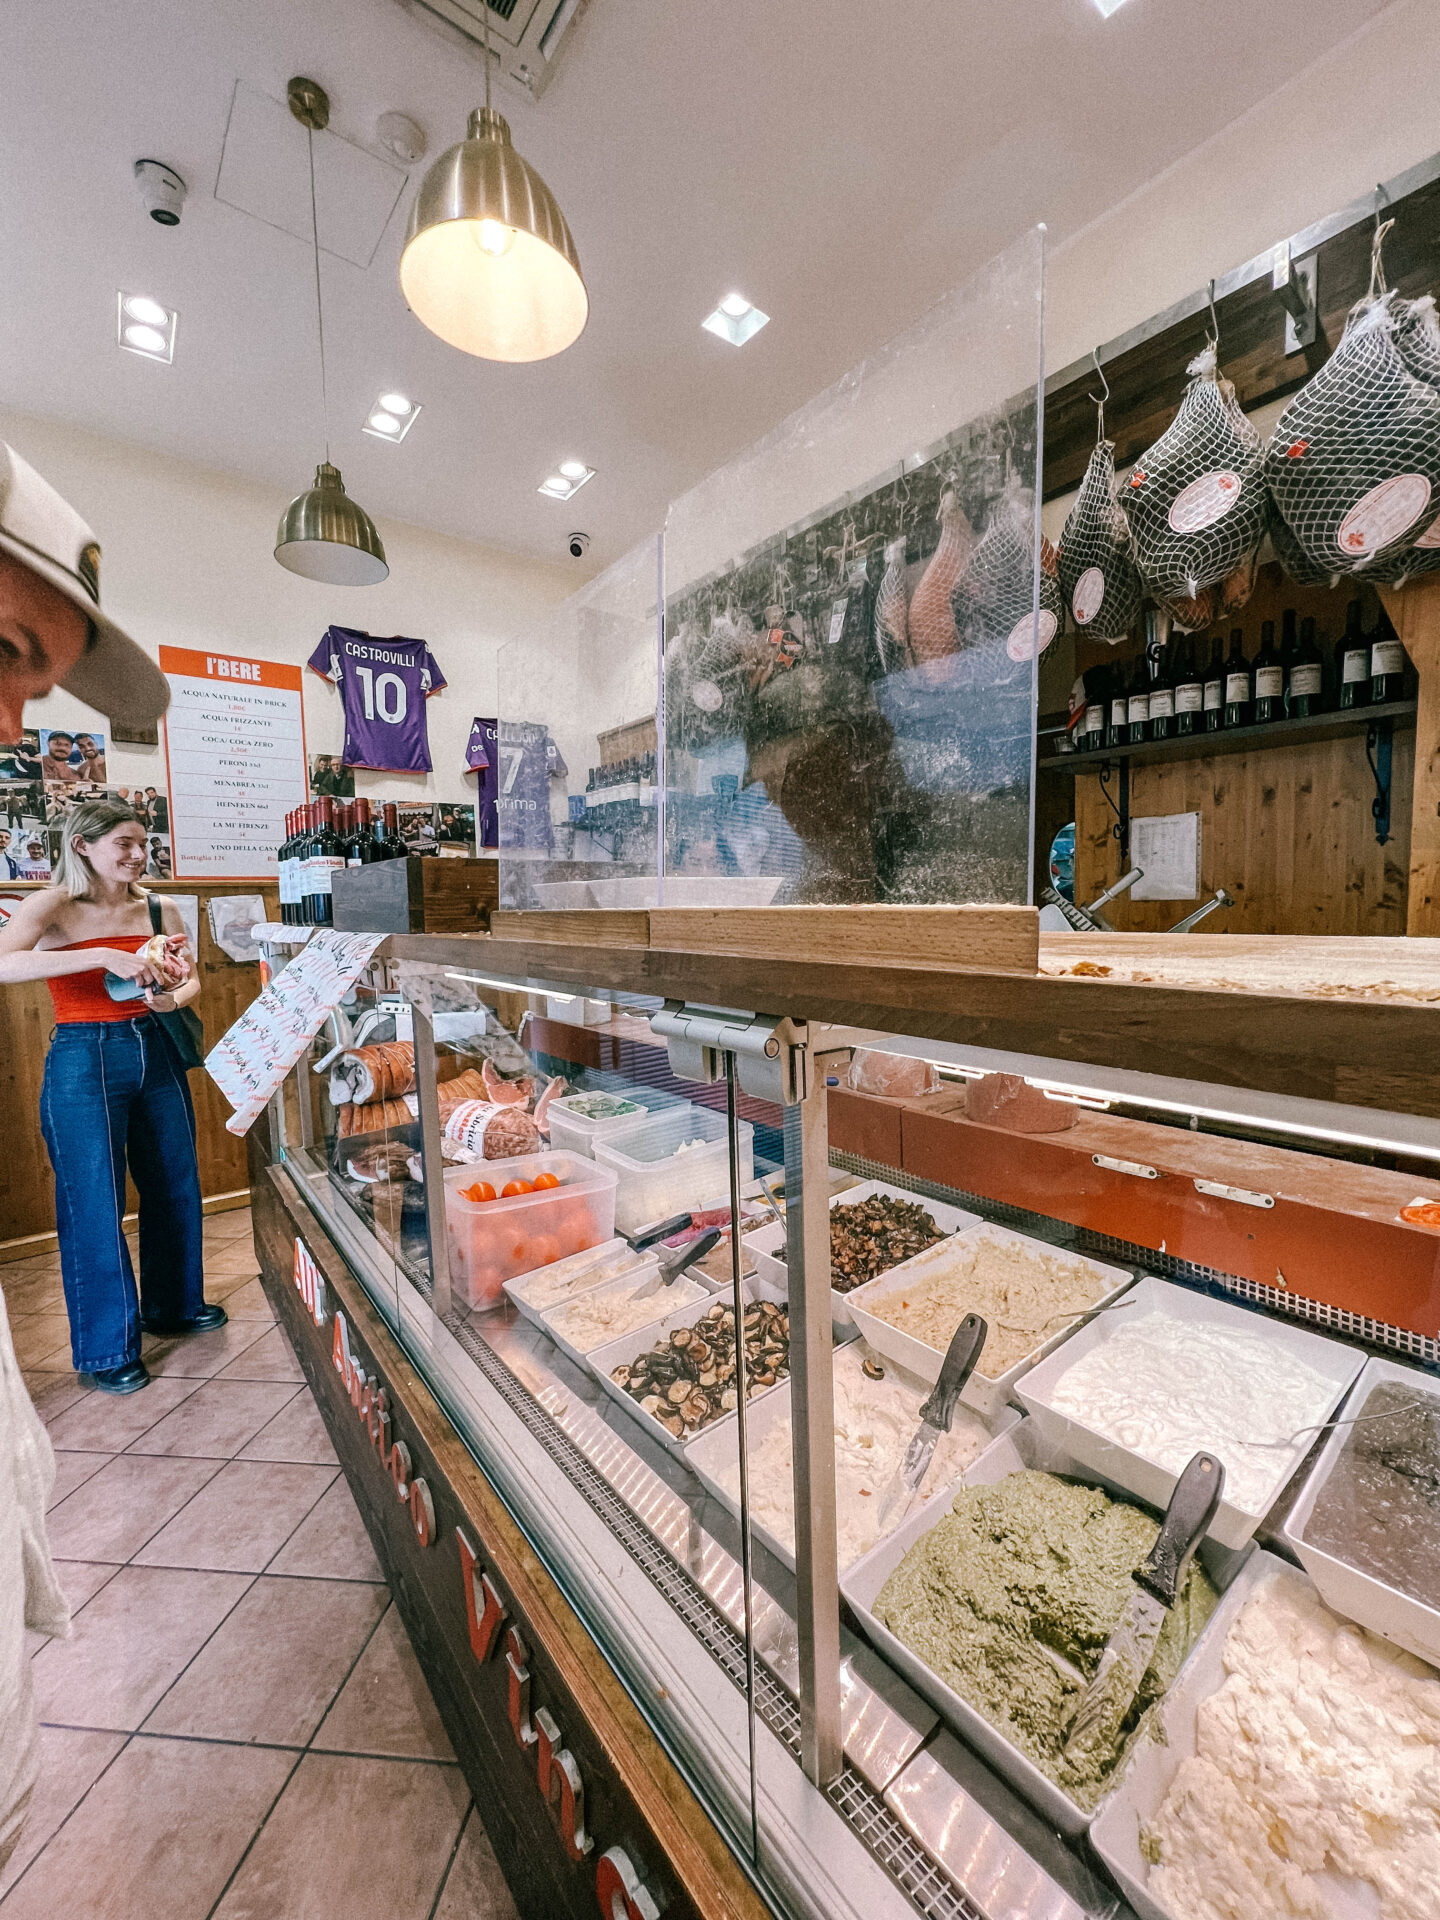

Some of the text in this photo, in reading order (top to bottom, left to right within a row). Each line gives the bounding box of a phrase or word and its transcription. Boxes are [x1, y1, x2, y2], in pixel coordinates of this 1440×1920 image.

[345, 642, 415, 667] CASTROVILLI
[182, 689, 210, 698] ACQUA
[212, 693, 252, 703] NATURALE
[264, 699, 287, 708] BRICK
[355, 666, 407, 724] 10
[201, 714, 272, 727] ACQUA FRIZZANTE
[229, 738, 252, 746] COCA
[219, 759, 248, 767] PERONI
[499, 746, 524, 794] 7
[214, 780, 256, 788] MENABREA
[216, 801, 256, 809] HEINEKEN
[181, 854, 212, 862] Bottiglia
[332, 1310, 437, 1548] Antico
